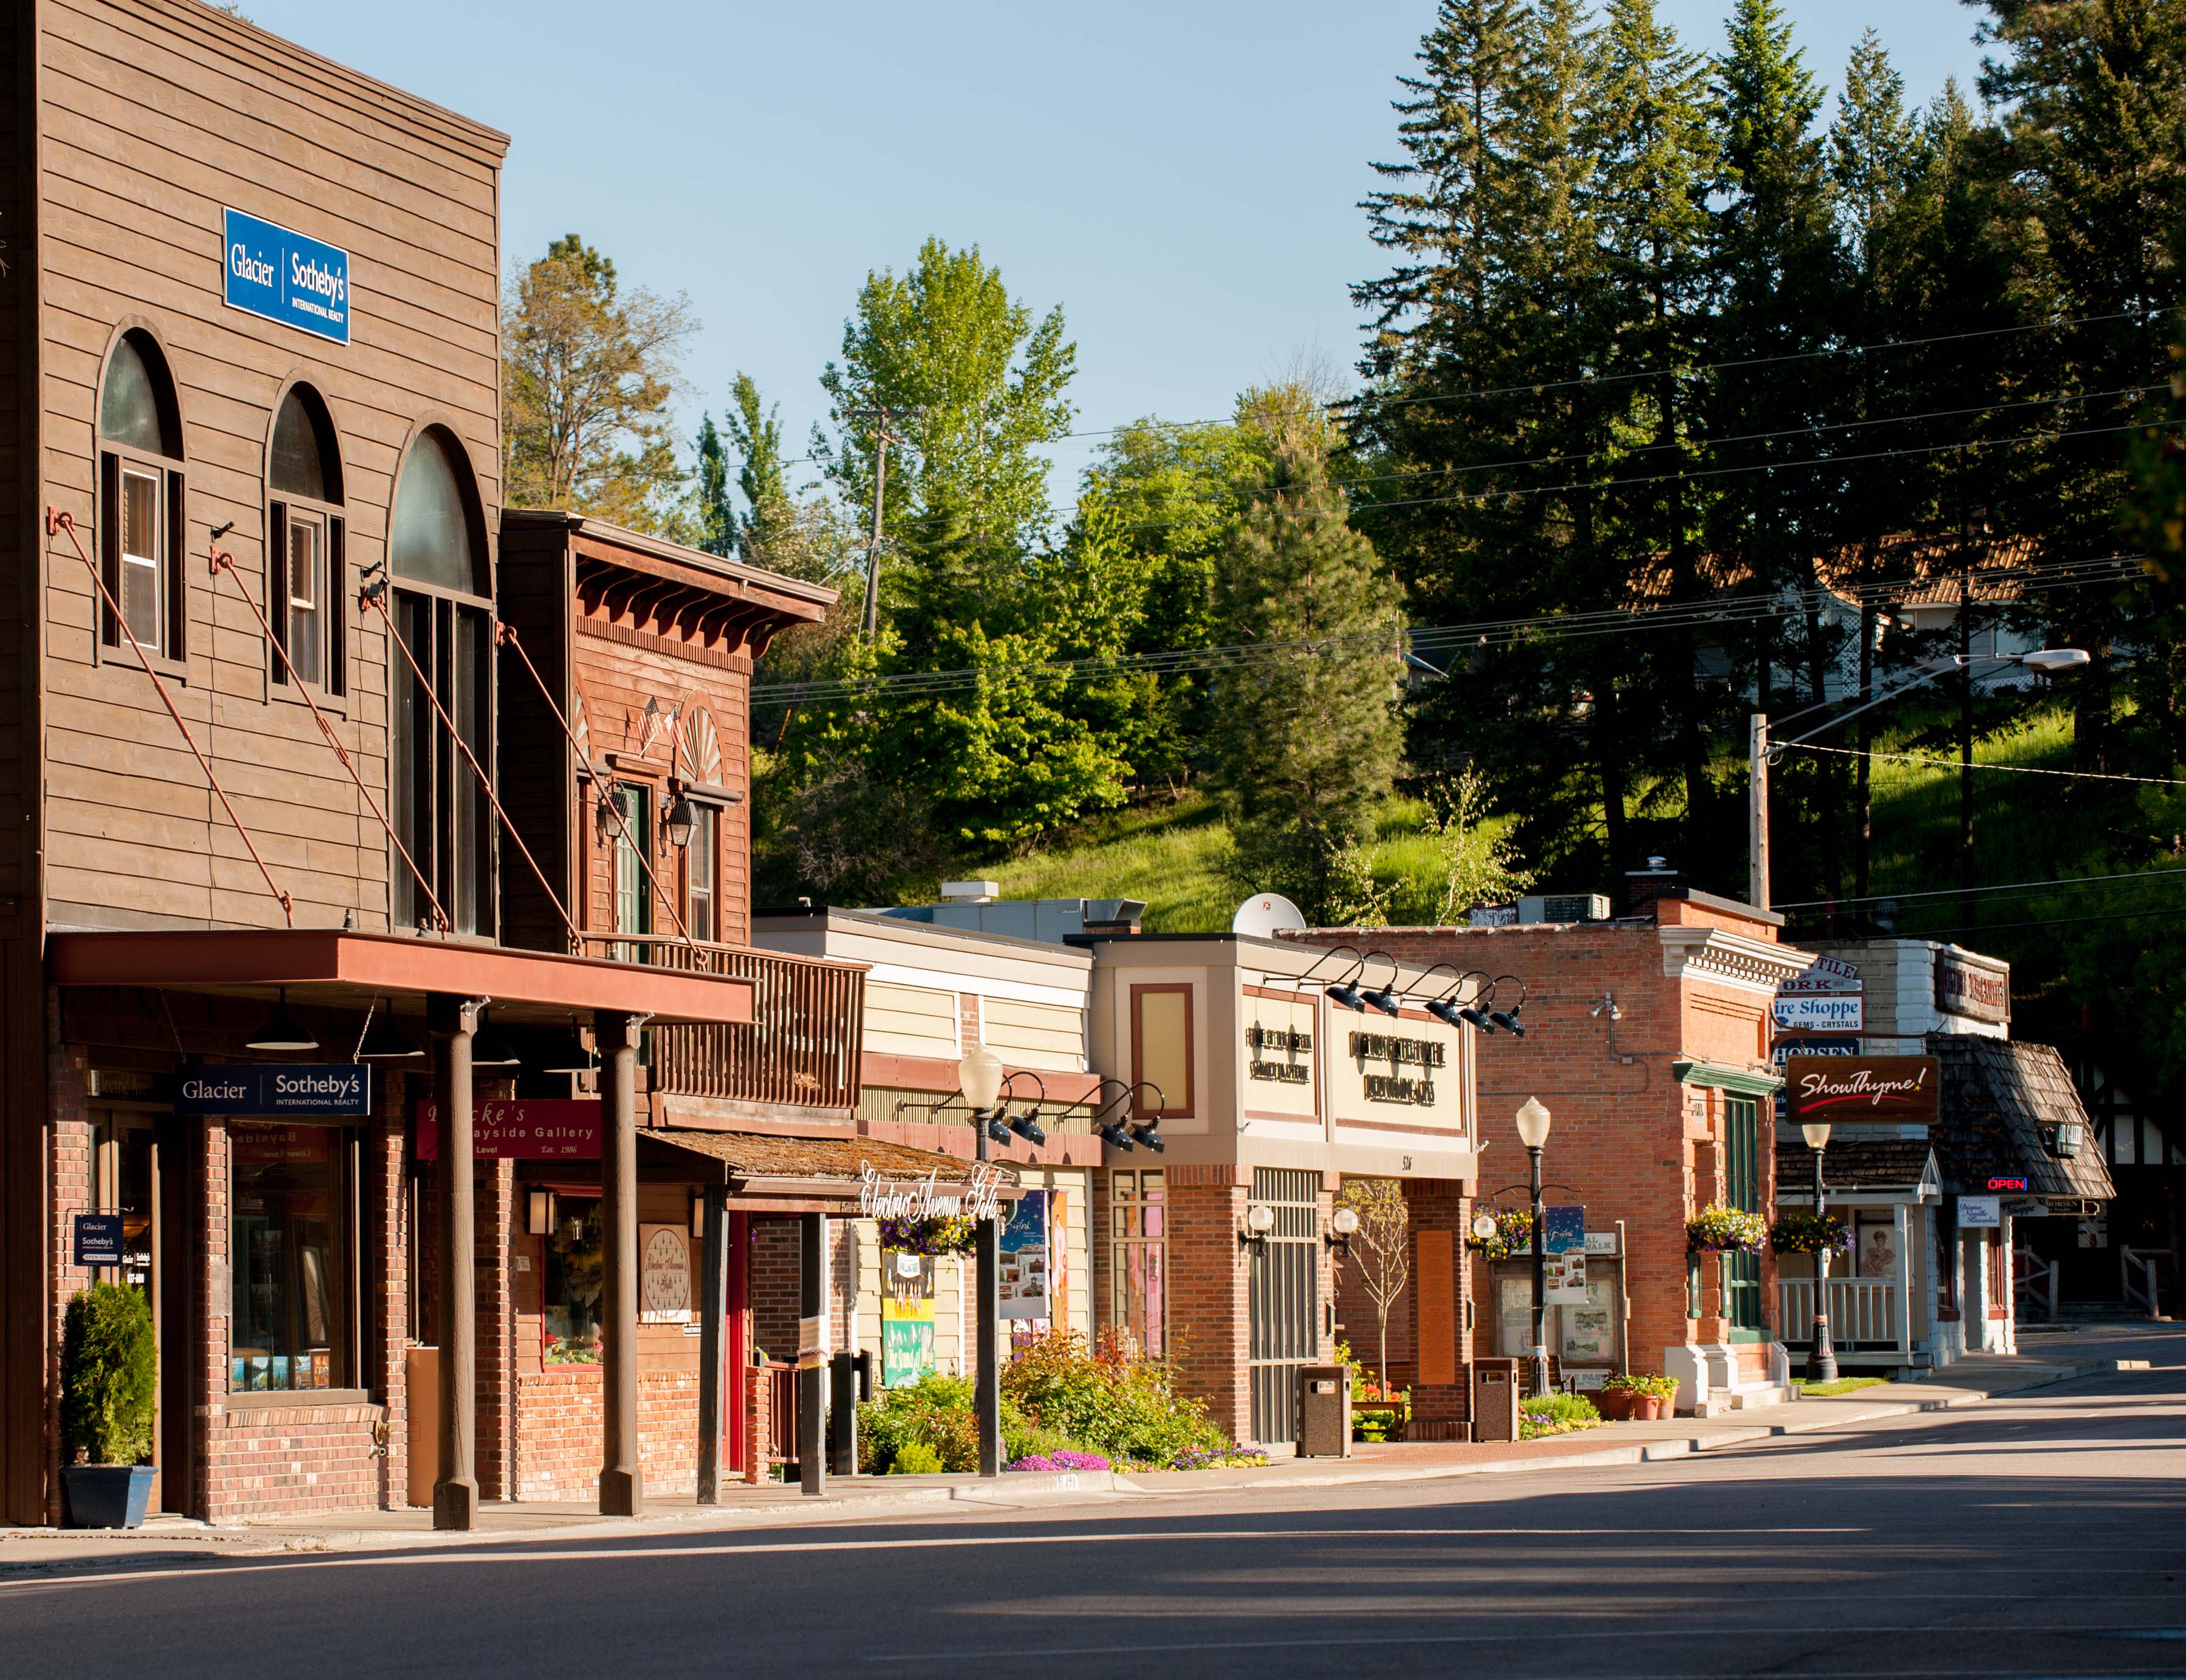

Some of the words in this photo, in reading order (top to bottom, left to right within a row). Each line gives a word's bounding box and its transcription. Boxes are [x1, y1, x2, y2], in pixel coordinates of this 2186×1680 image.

[231, 244, 274, 287] Glacier
[292, 252, 344, 307] Sotheby's
[292, 297, 327, 318] INTERNATIONAL
[328, 309, 344, 324] REALTY
[1816, 957, 1854, 979] TILE
[1783, 980, 1832, 991] ORK
[1775, 1001, 1795, 1014] ire
[1800, 999, 1859, 1019] Shoppe
[182, 1080, 247, 1099] Glacier
[276, 1074, 360, 1098] Sotheby's
[1800, 1067, 1927, 1105] ShowThyme!
[474, 1128, 526, 1140] ayside
[535, 1127, 593, 1139] Gallery
[861, 1159, 909, 1218] Electric
[908, 1167, 961, 1223] Avenue
[1988, 1179, 2024, 1189] OPEN
[82, 1237, 113, 1246] Sotheby's
